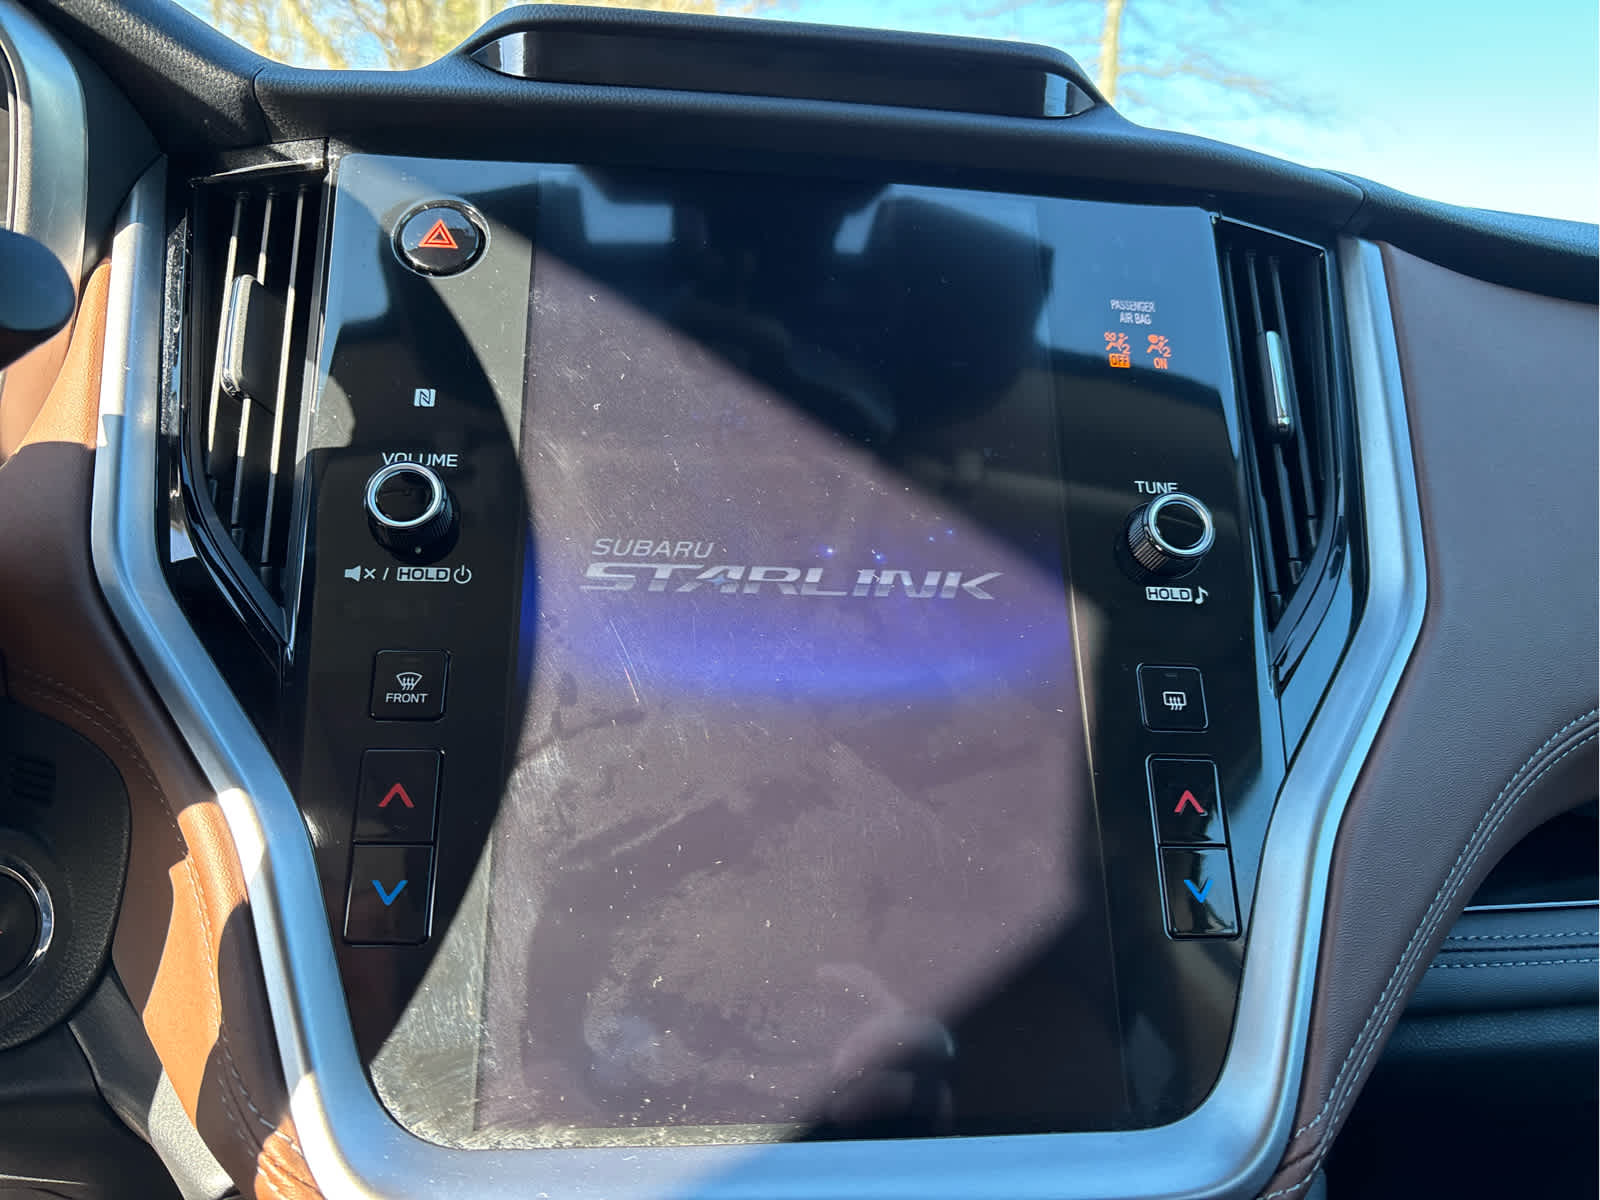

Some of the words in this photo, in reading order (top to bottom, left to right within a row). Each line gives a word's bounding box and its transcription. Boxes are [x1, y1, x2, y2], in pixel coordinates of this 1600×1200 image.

[1110, 299, 1155, 312] PASSENGER
[1120, 311, 1133, 323] AIR
[1134, 312, 1152, 325] BAG
[1110, 354, 1130, 367] OFF
[1153, 357, 1168, 369] ON
[382, 452, 459, 467] VOLUME
[1134, 480, 1179, 494] TUNE
[592, 538, 714, 559] SUBARU
[397, 567, 450, 582] HOLD
[580, 562, 1002, 600] STARLINK
[1146, 586, 1192, 602] HOLD
[385, 692, 429, 703] FRONT
